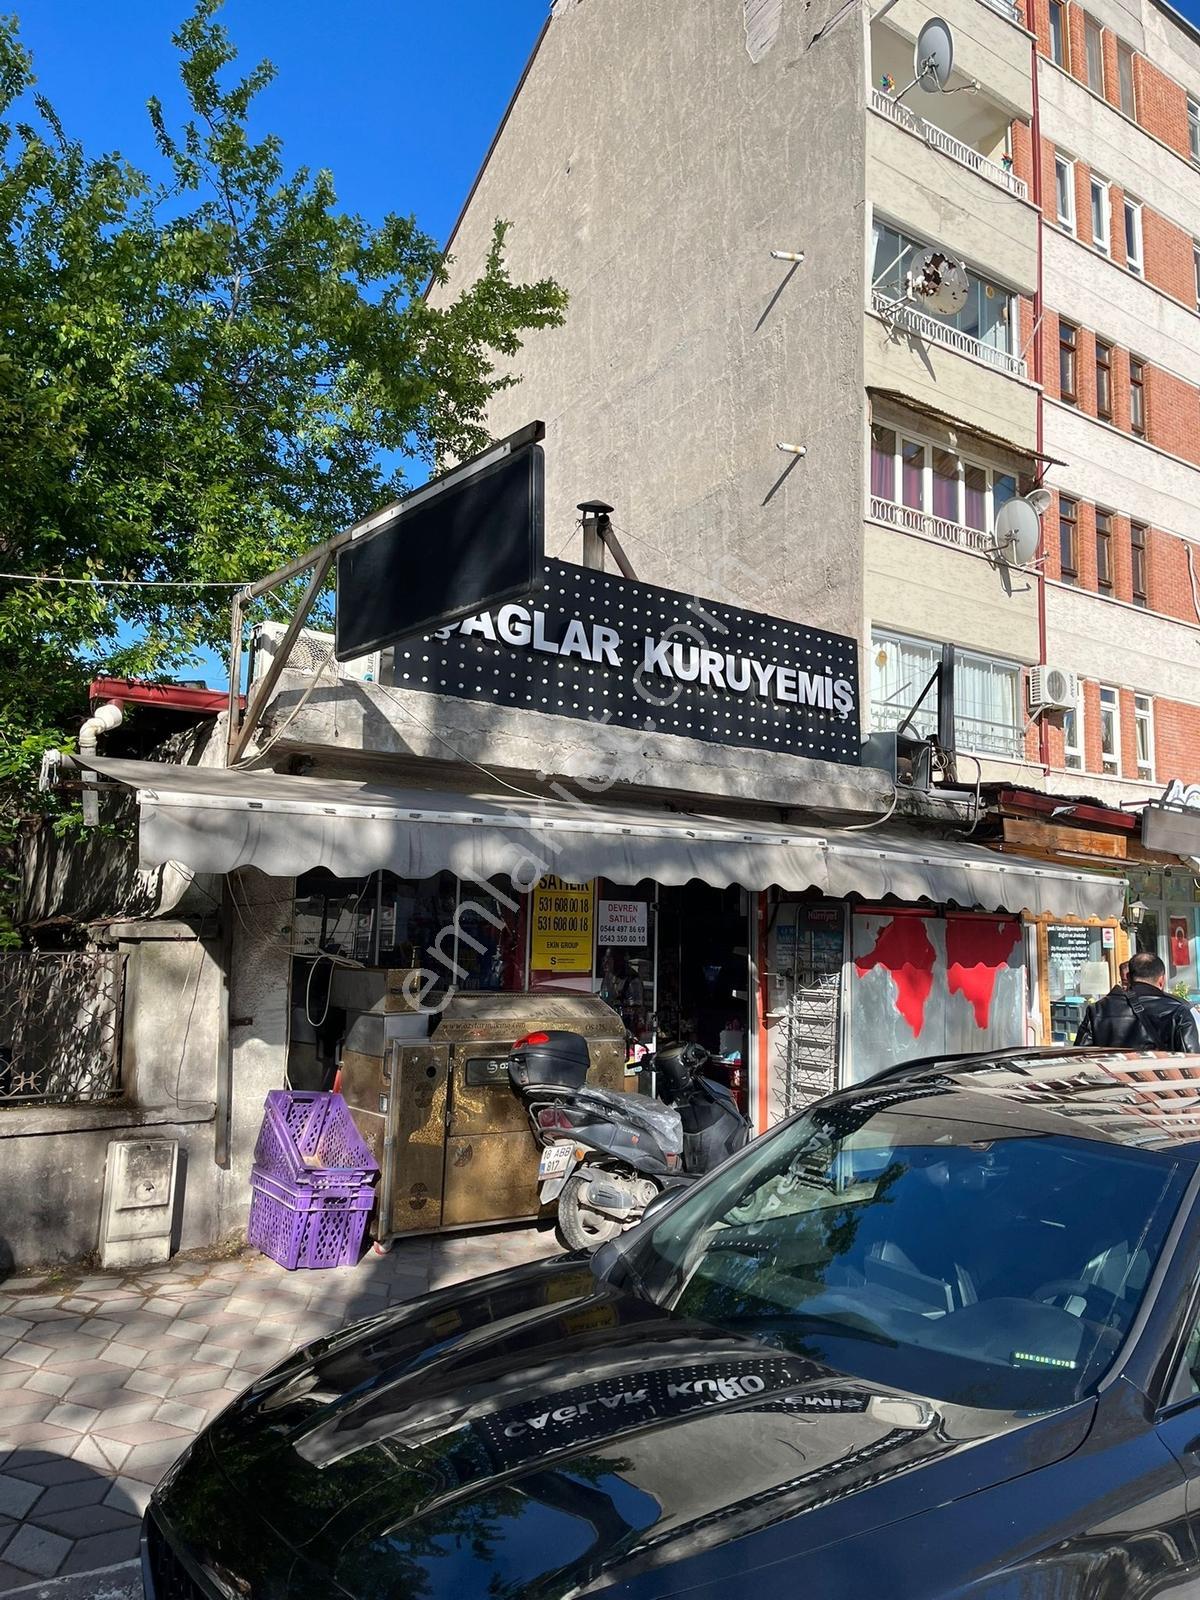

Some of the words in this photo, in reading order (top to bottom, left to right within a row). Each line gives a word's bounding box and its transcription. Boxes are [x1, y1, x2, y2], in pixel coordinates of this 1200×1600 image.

[644, 637, 854, 719] KURUYEMİŞ
[539, 897, 552, 911] 531
[555, 897, 568, 912] 608
[570, 898, 579, 912] 00
[581, 899, 589, 913] 18
[608, 904, 638, 912] DEVREN
[538, 916, 551, 930] 531
[554, 917, 567, 931] 608
[569, 917, 577, 931] 00
[581, 917, 588, 931] 18
[609, 915, 637, 923] SATILIK
[544, 1149, 552, 1160] 18
